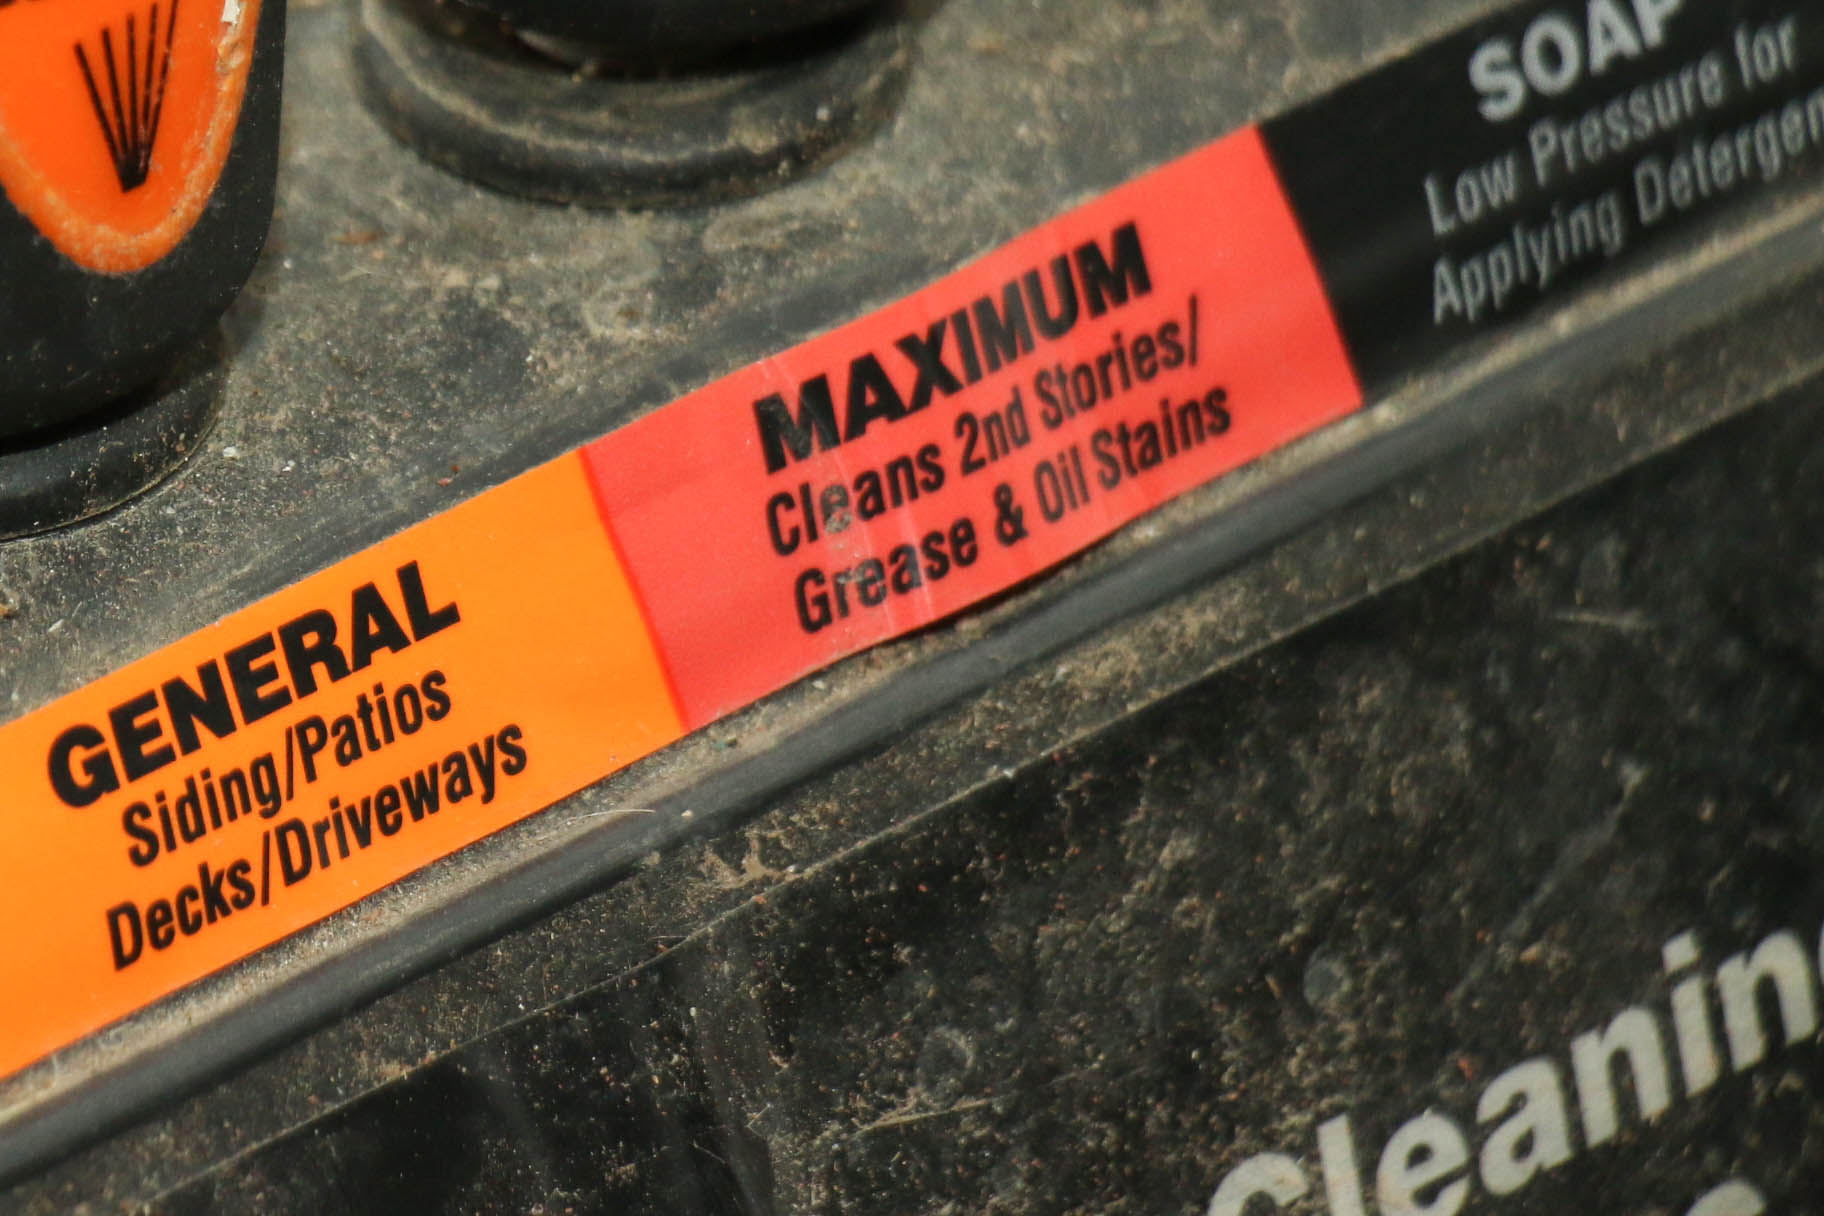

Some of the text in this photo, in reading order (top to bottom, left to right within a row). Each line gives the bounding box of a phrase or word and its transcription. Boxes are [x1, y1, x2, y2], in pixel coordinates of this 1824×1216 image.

[1424, 16, 1797, 236] Low Pressure for
[752, 221, 1152, 474] MAXIMUM
[1431, 189, 1625, 324] Applying
[766, 294, 1200, 556] Cleans 2nd Stories/
[794, 385, 1233, 635] Grease & Oil Stains
[47, 560, 461, 808] GENERAL
[121, 669, 451, 867] Siding/Patios
[106, 724, 528, 971] Decks/Driveways
[1208, 922, 1824, 1216] leanin
